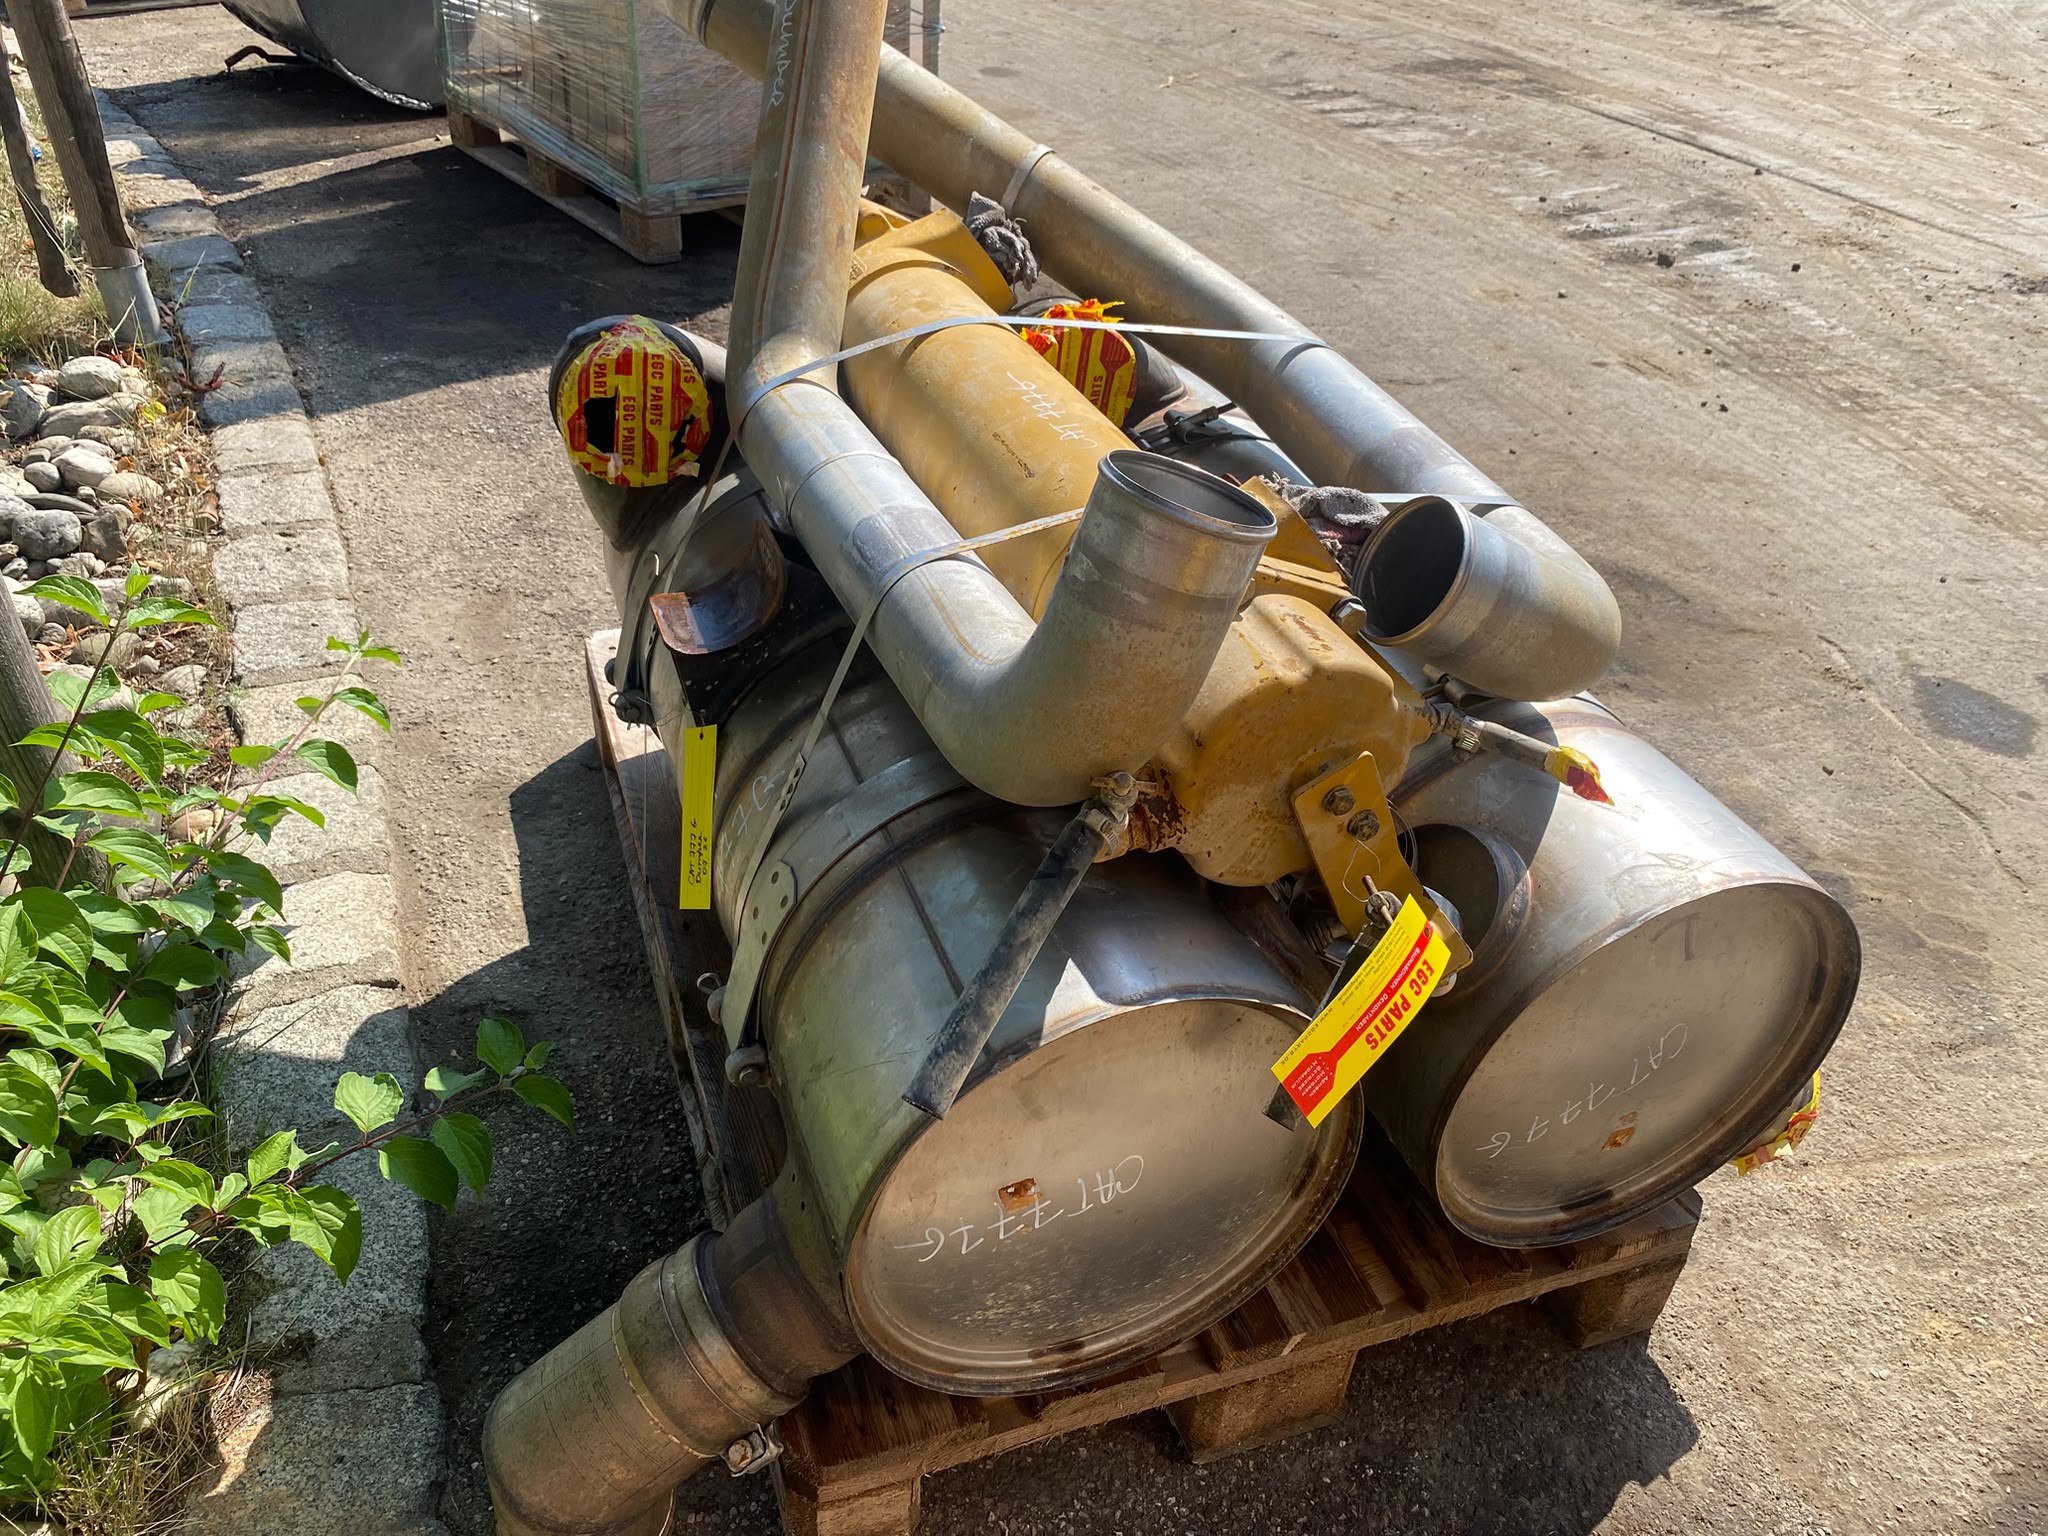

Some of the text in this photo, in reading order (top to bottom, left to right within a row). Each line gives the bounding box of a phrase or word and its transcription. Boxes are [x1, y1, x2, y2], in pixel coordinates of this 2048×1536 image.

[593, 362, 608, 396] PART
[649, 353, 665, 426] EGC PARTS
[621, 396, 636, 466] EGC PARTS
[1408, 959, 1435, 997] EGC
[1365, 993, 1412, 1050] PARTS
[1613, 1022, 1689, 1098] CAT
[1066, 1154, 1145, 1217] CAT
